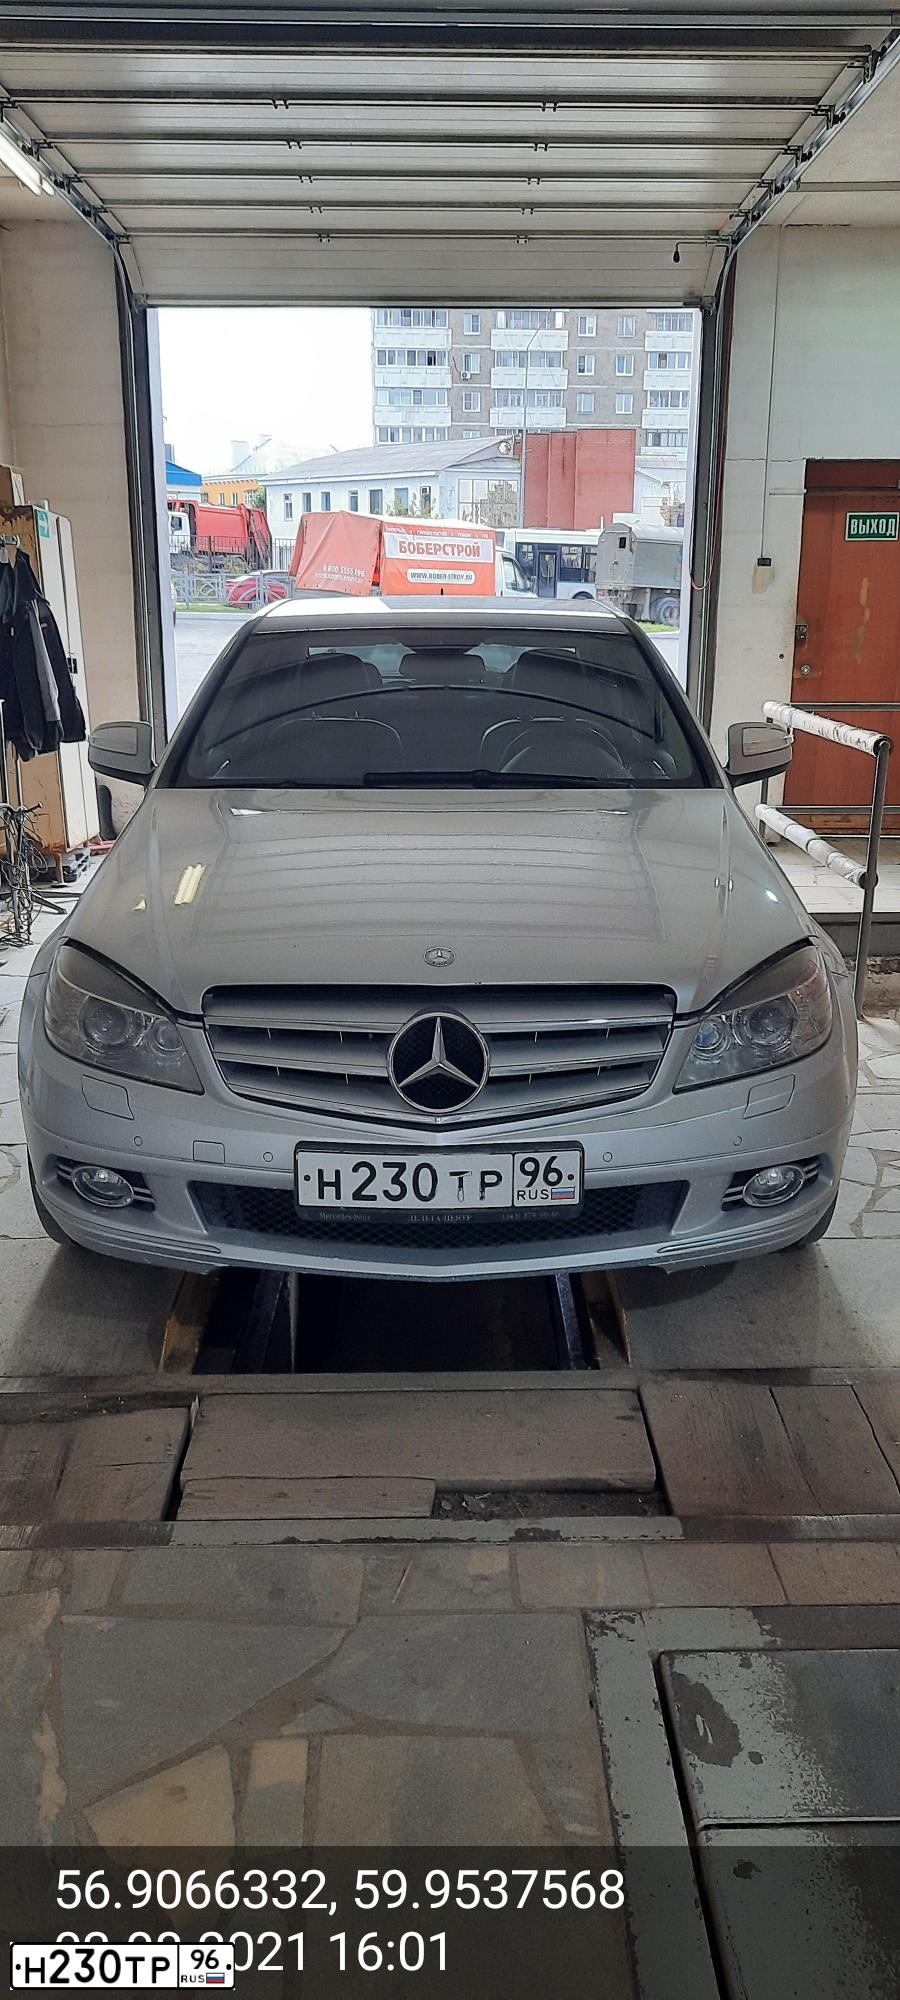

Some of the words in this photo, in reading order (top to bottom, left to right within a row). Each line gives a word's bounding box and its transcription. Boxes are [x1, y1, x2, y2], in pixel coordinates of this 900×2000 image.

[850, 518, 896, 537] ВЫХОД
[398, 540, 482, 558] БОБЕРСТРОЙ
[519, 1155, 564, 1188] 96
[517, 1189, 550, 1201] RUS
